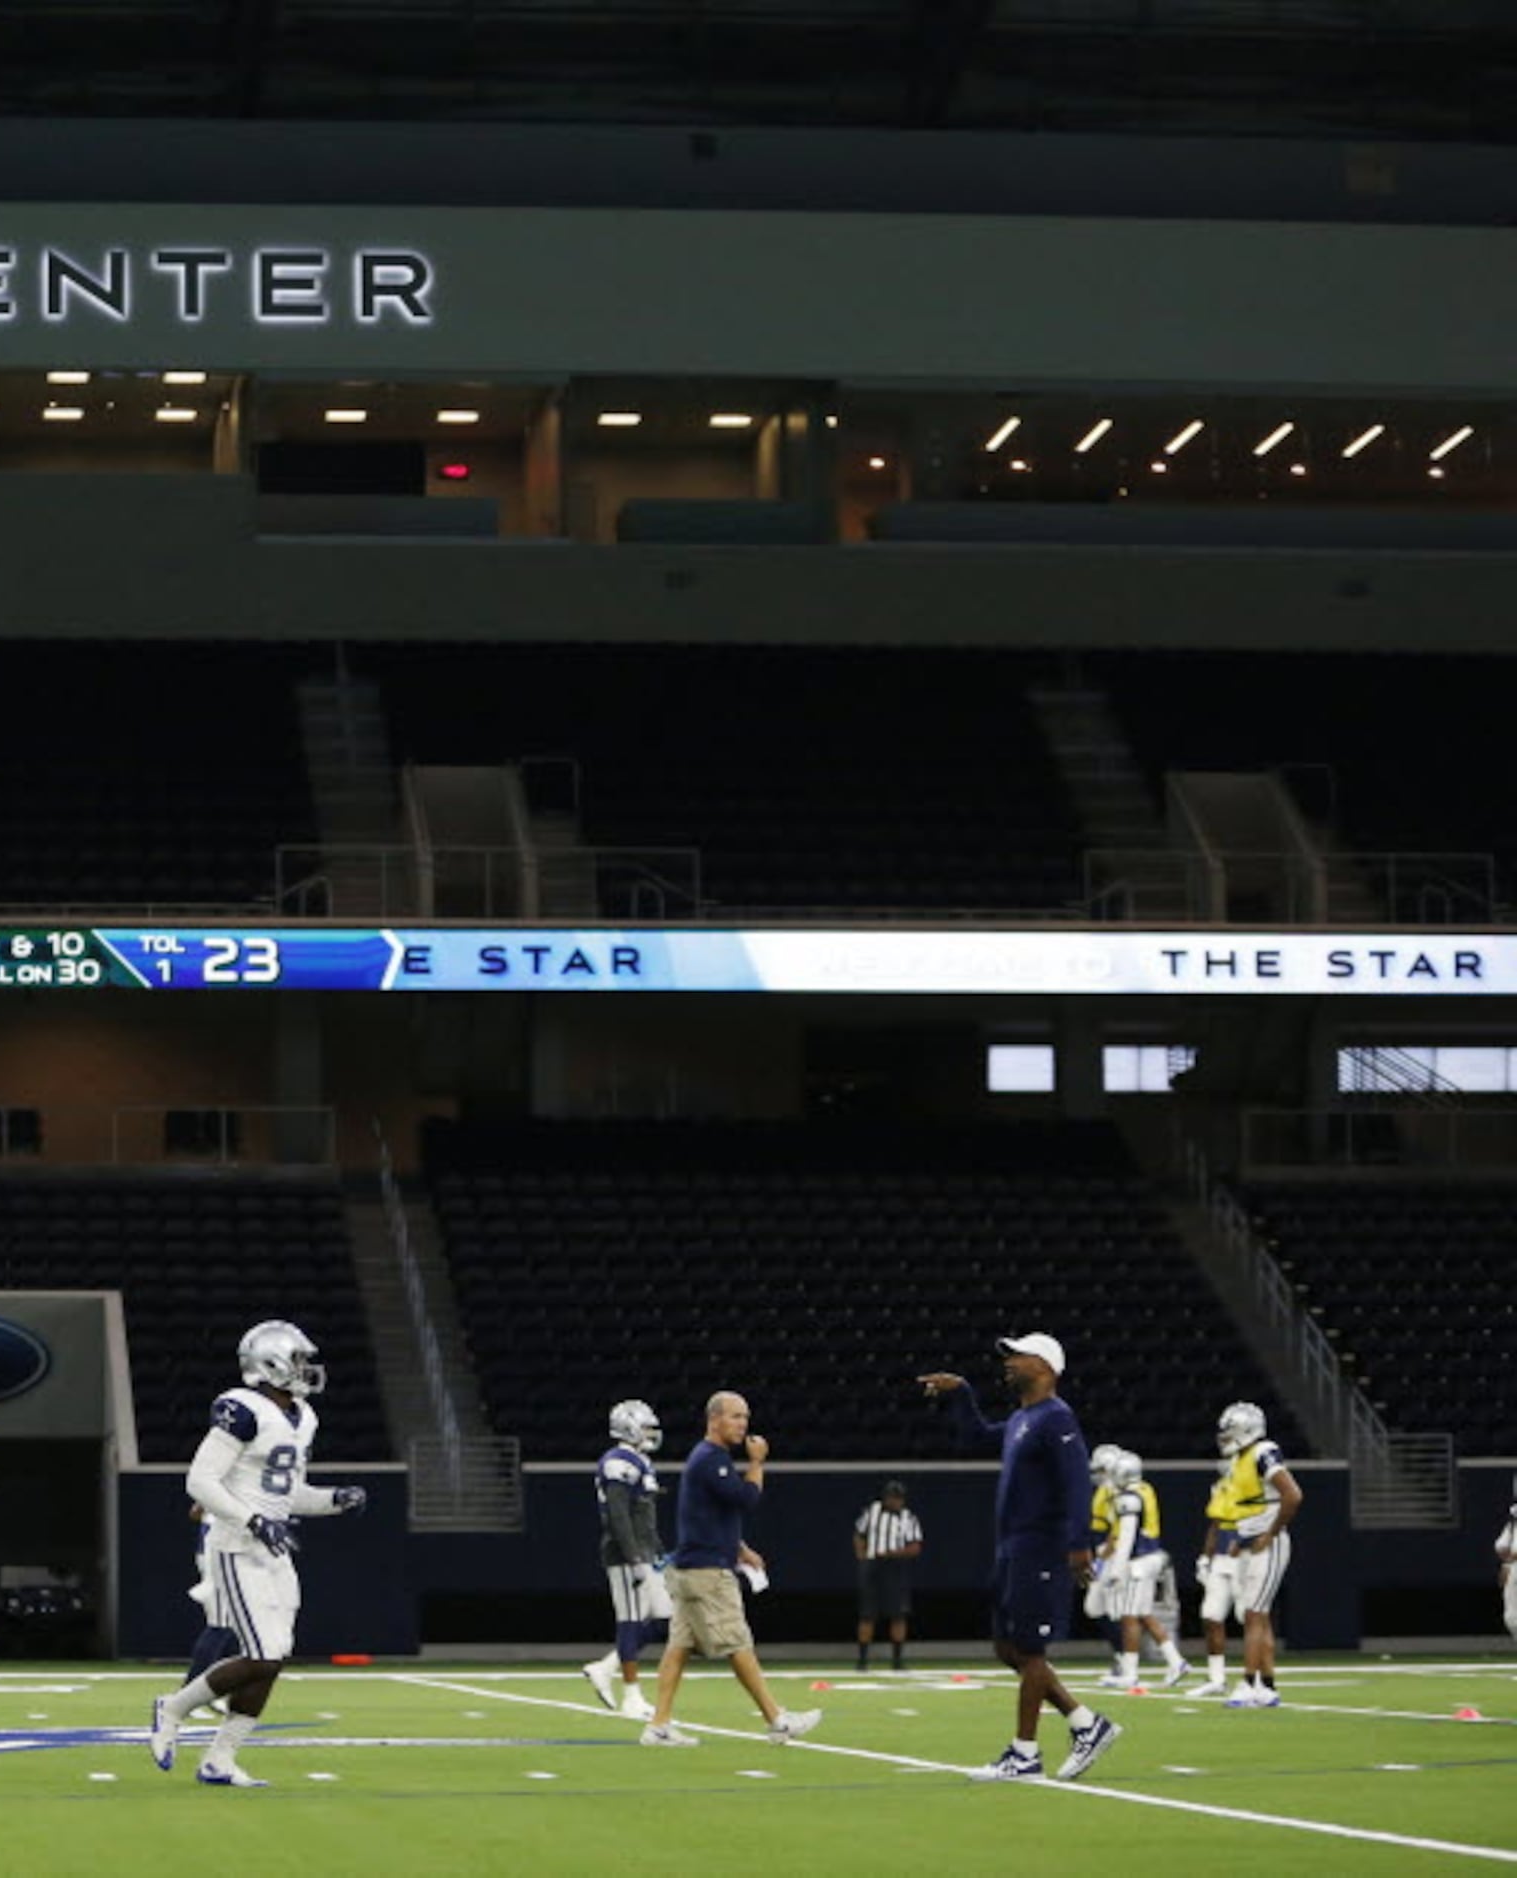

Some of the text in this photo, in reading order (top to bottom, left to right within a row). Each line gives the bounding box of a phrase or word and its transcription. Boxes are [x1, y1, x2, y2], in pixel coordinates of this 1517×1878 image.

[11, 935, 34, 958] &
[47, 932, 84, 956] 10
[139, 936, 185, 953] TOL
[57, 959, 100, 984] 30
[156, 958, 172, 982] 1
[203, 938, 280, 982] 23
[478, 946, 640, 975] STAR
[1161, 951, 1482, 978] THE STAR
[261, 1445, 312, 1496] 8
